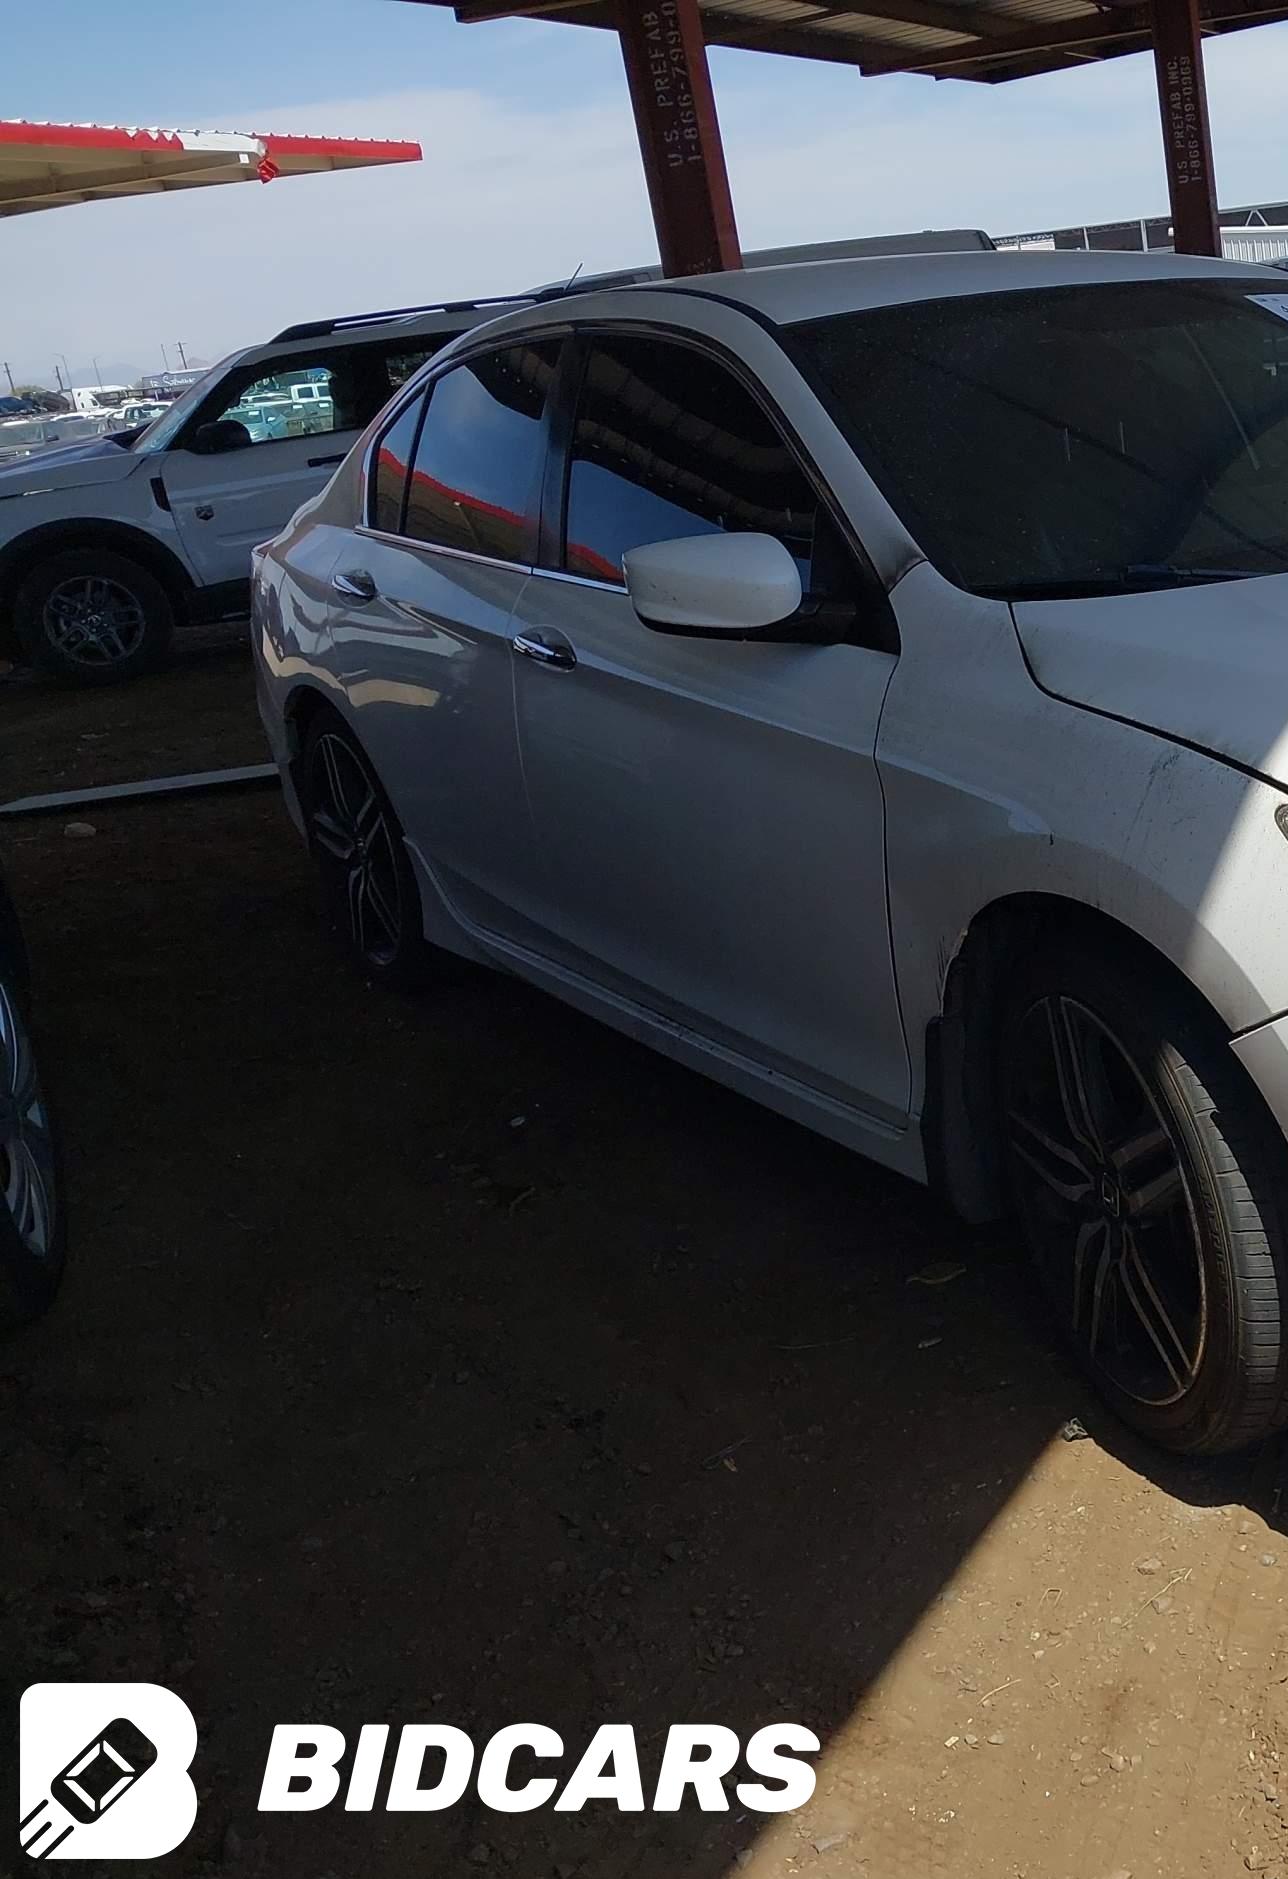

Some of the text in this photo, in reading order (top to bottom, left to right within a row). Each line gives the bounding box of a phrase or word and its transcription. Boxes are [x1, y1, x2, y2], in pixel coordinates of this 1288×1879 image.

[642, 10, 684, 168] U.S. PREFAB
[1169, 92, 1185, 149] PREFAB
